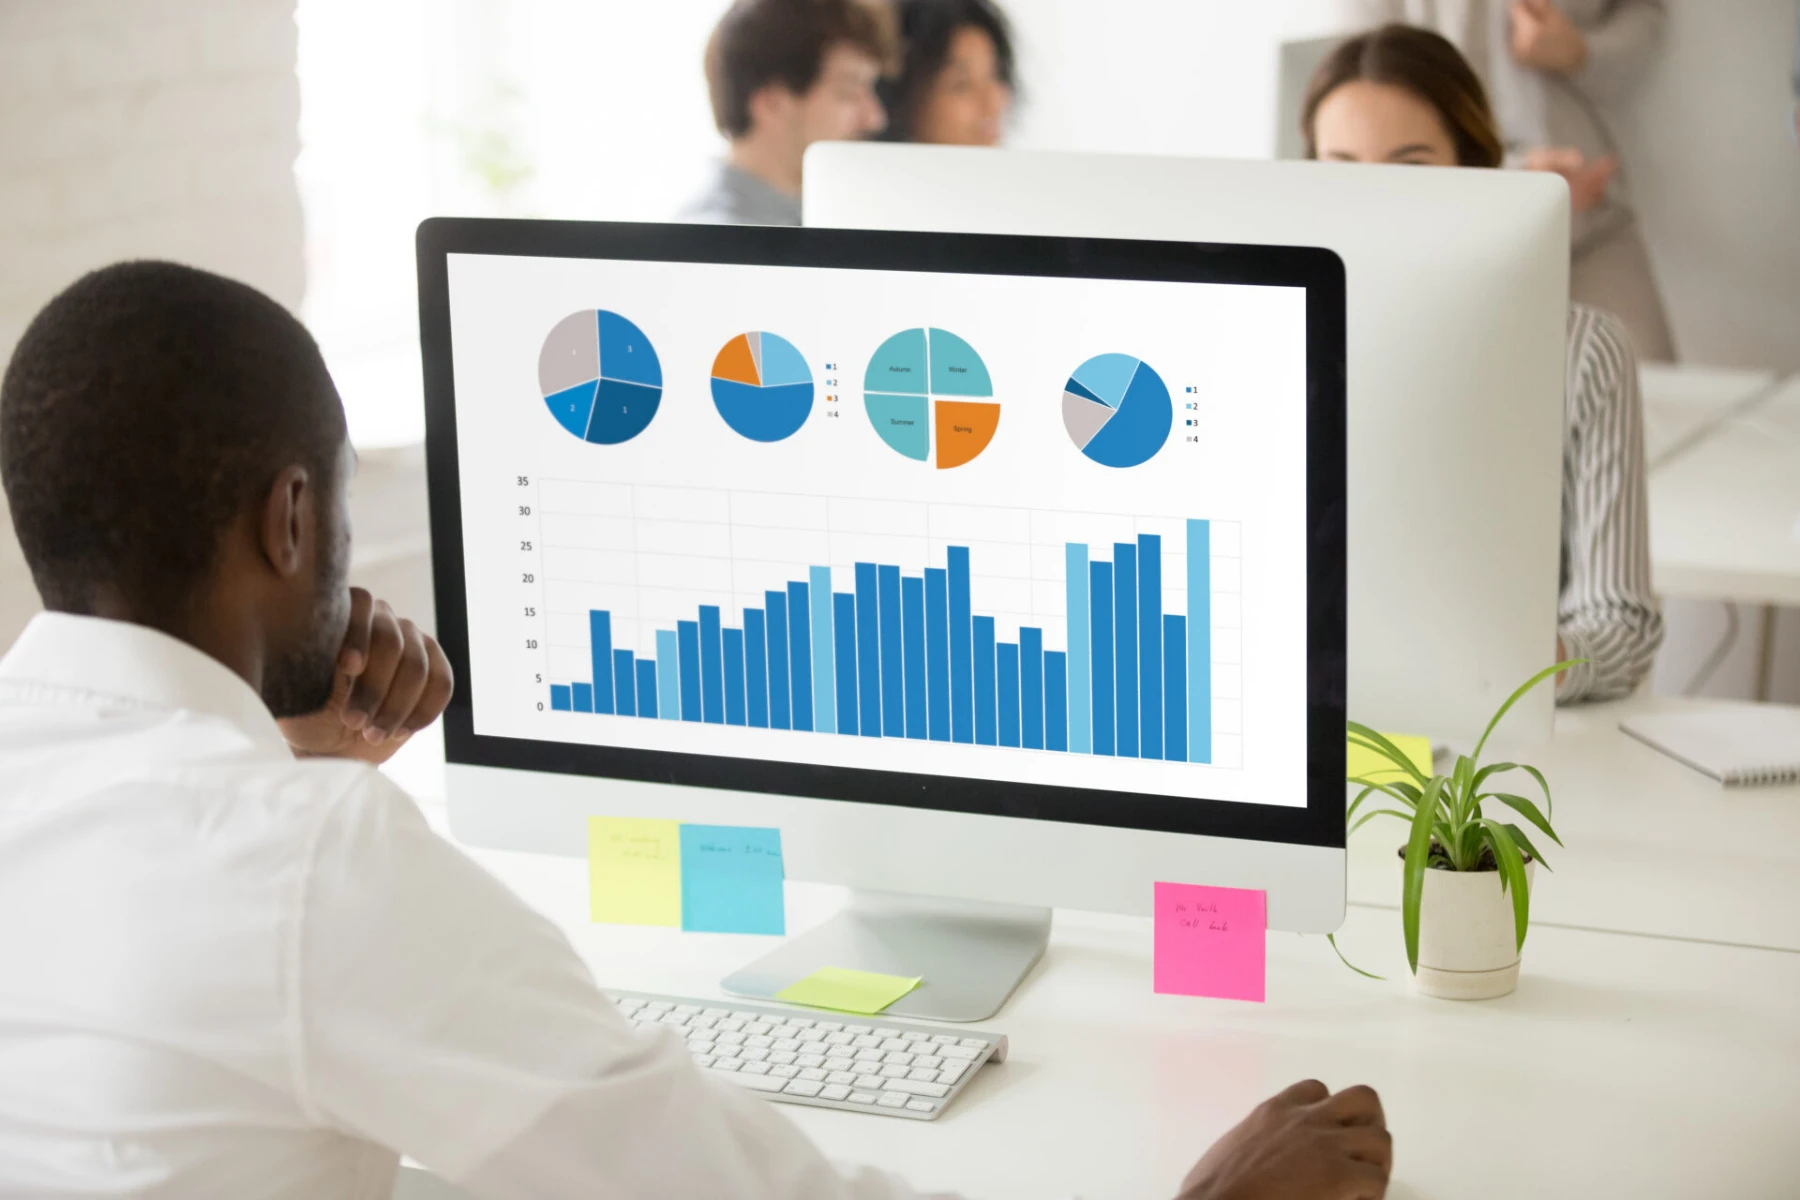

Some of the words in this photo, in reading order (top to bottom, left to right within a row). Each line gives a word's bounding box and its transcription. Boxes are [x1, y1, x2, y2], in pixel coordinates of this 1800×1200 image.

[888, 365, 912, 373] Autumn
[947, 366, 968, 374] Winter
[890, 418, 915, 426] Summer
[953, 424, 973, 434] Spring
[517, 476, 530, 487] 35
[518, 506, 531, 517] 30
[520, 541, 533, 552] 25
[522, 573, 535, 584] 20
[524, 606, 536, 617] 15
[526, 639, 538, 650] 10
[535, 673, 543, 684] 5
[536, 701, 545, 712] 0
